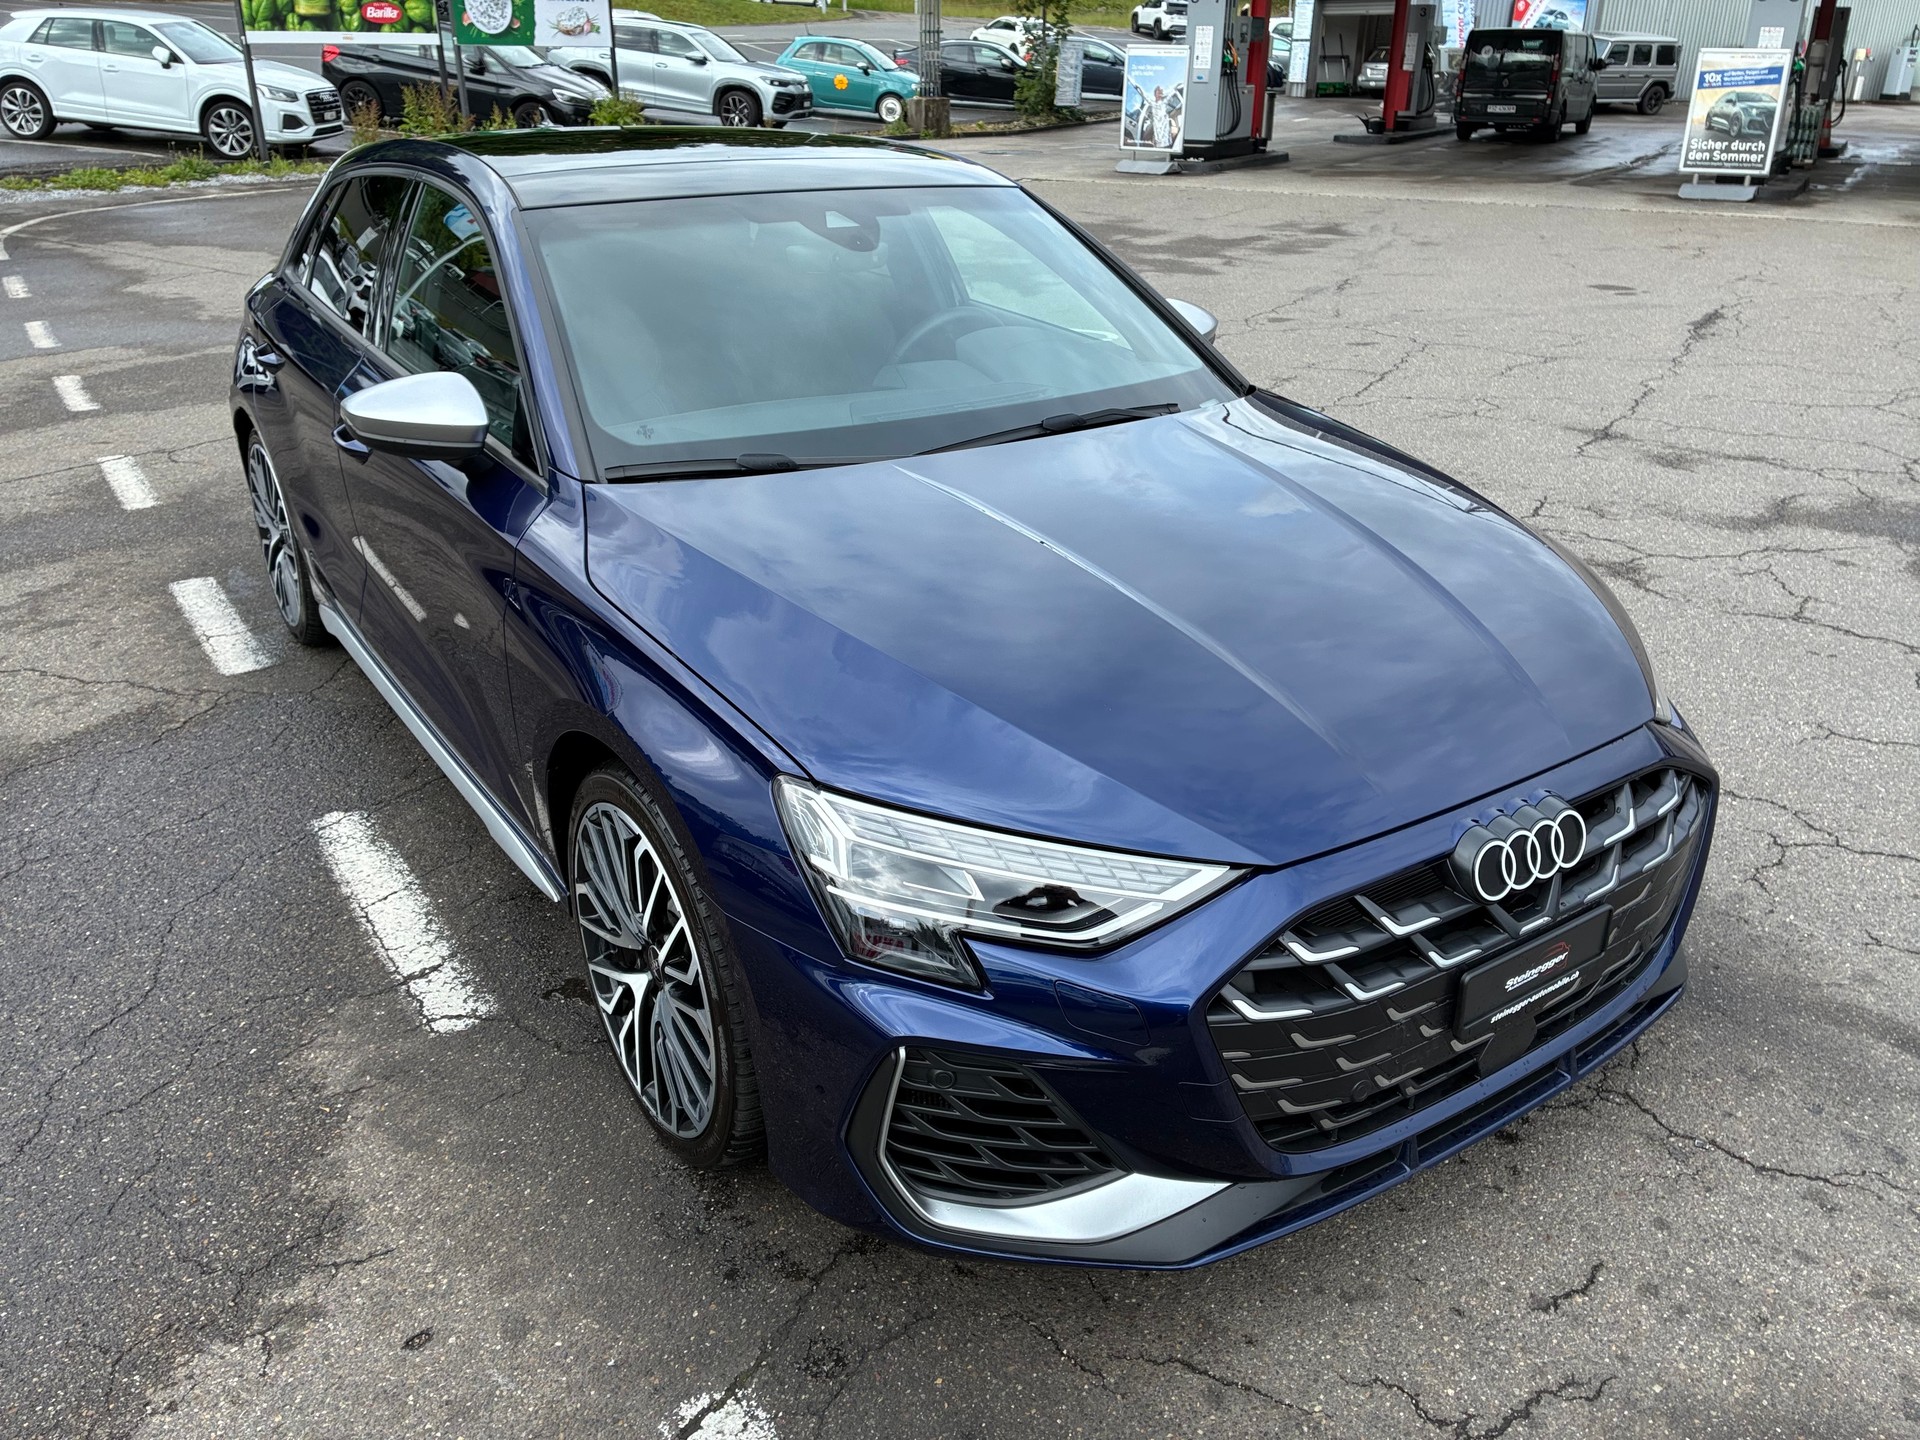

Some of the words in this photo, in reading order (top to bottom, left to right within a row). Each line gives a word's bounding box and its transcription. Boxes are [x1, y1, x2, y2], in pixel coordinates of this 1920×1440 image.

[366, 6, 400, 18] Barilla
[1420, 7, 1427, 17] 3
[1703, 72, 1722, 83] 10x
[1689, 137, 1729, 150] Sicher
[1730, 139, 1766, 152] durch
[1688, 150, 1710, 161] den
[1712, 150, 1764, 163] Sommer
[1505, 951, 1569, 989] Steinegger
[1490, 970, 1580, 1024] steinegger-automobile.ch
